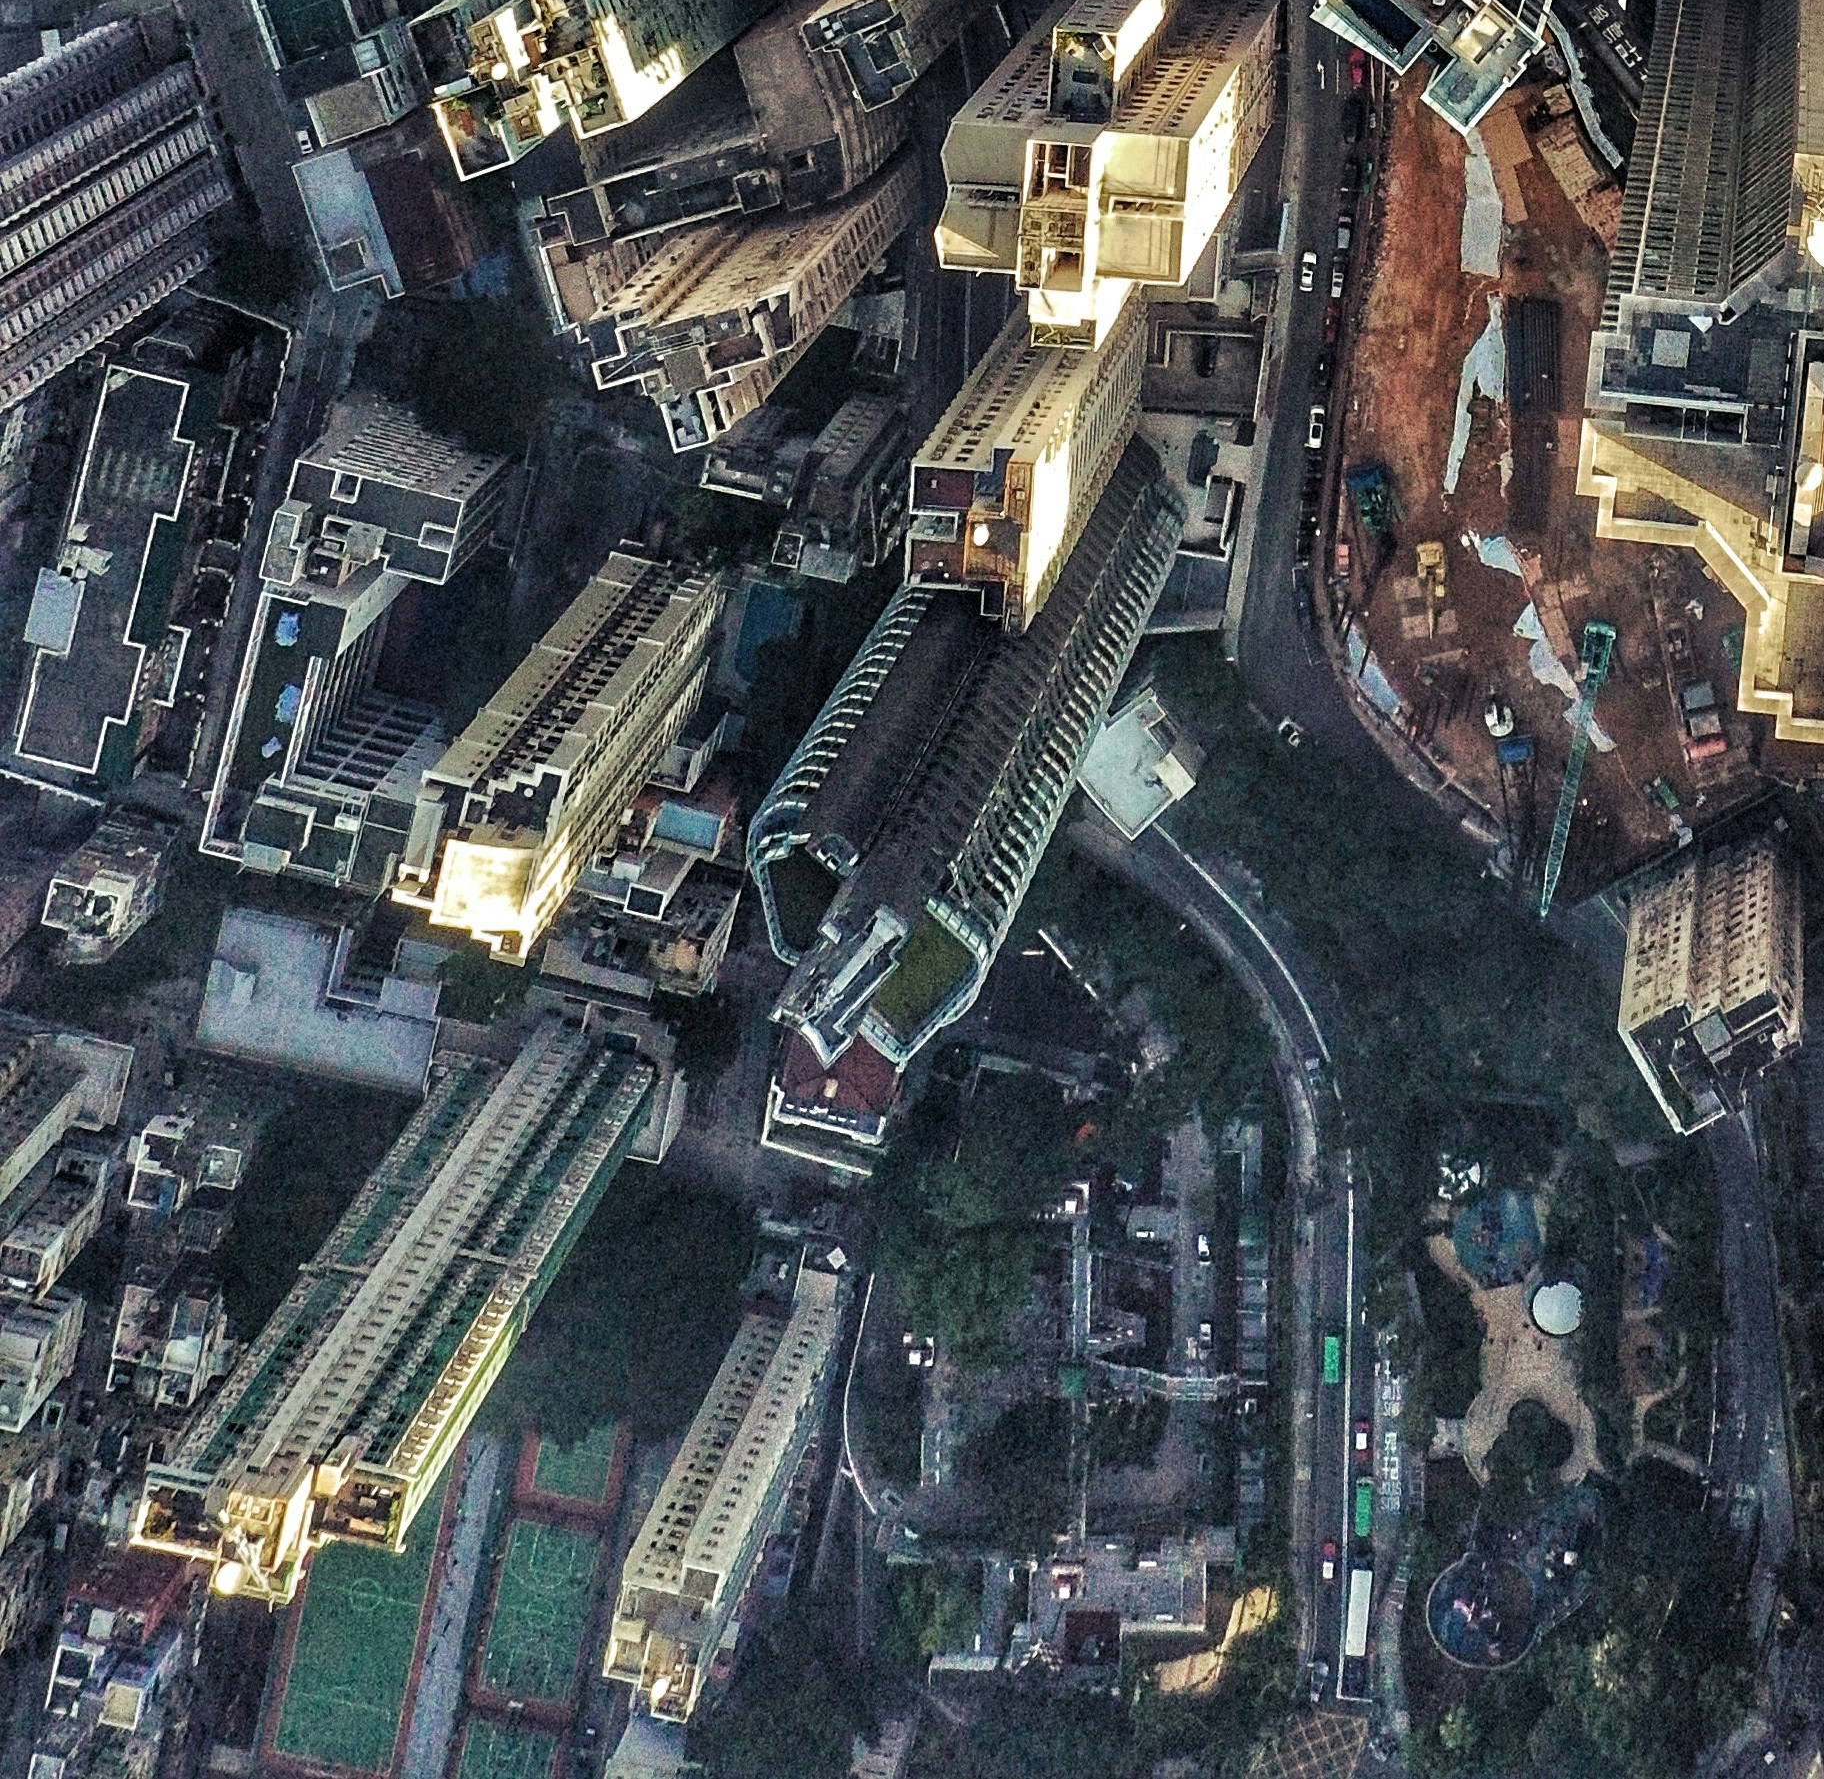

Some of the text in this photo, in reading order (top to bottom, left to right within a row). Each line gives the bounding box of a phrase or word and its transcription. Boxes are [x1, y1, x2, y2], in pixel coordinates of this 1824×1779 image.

[1589, 4, 1609, 25] BUS
[1602, 21, 1624, 44] STOP
[1380, 1481, 1402, 1496] STOP
